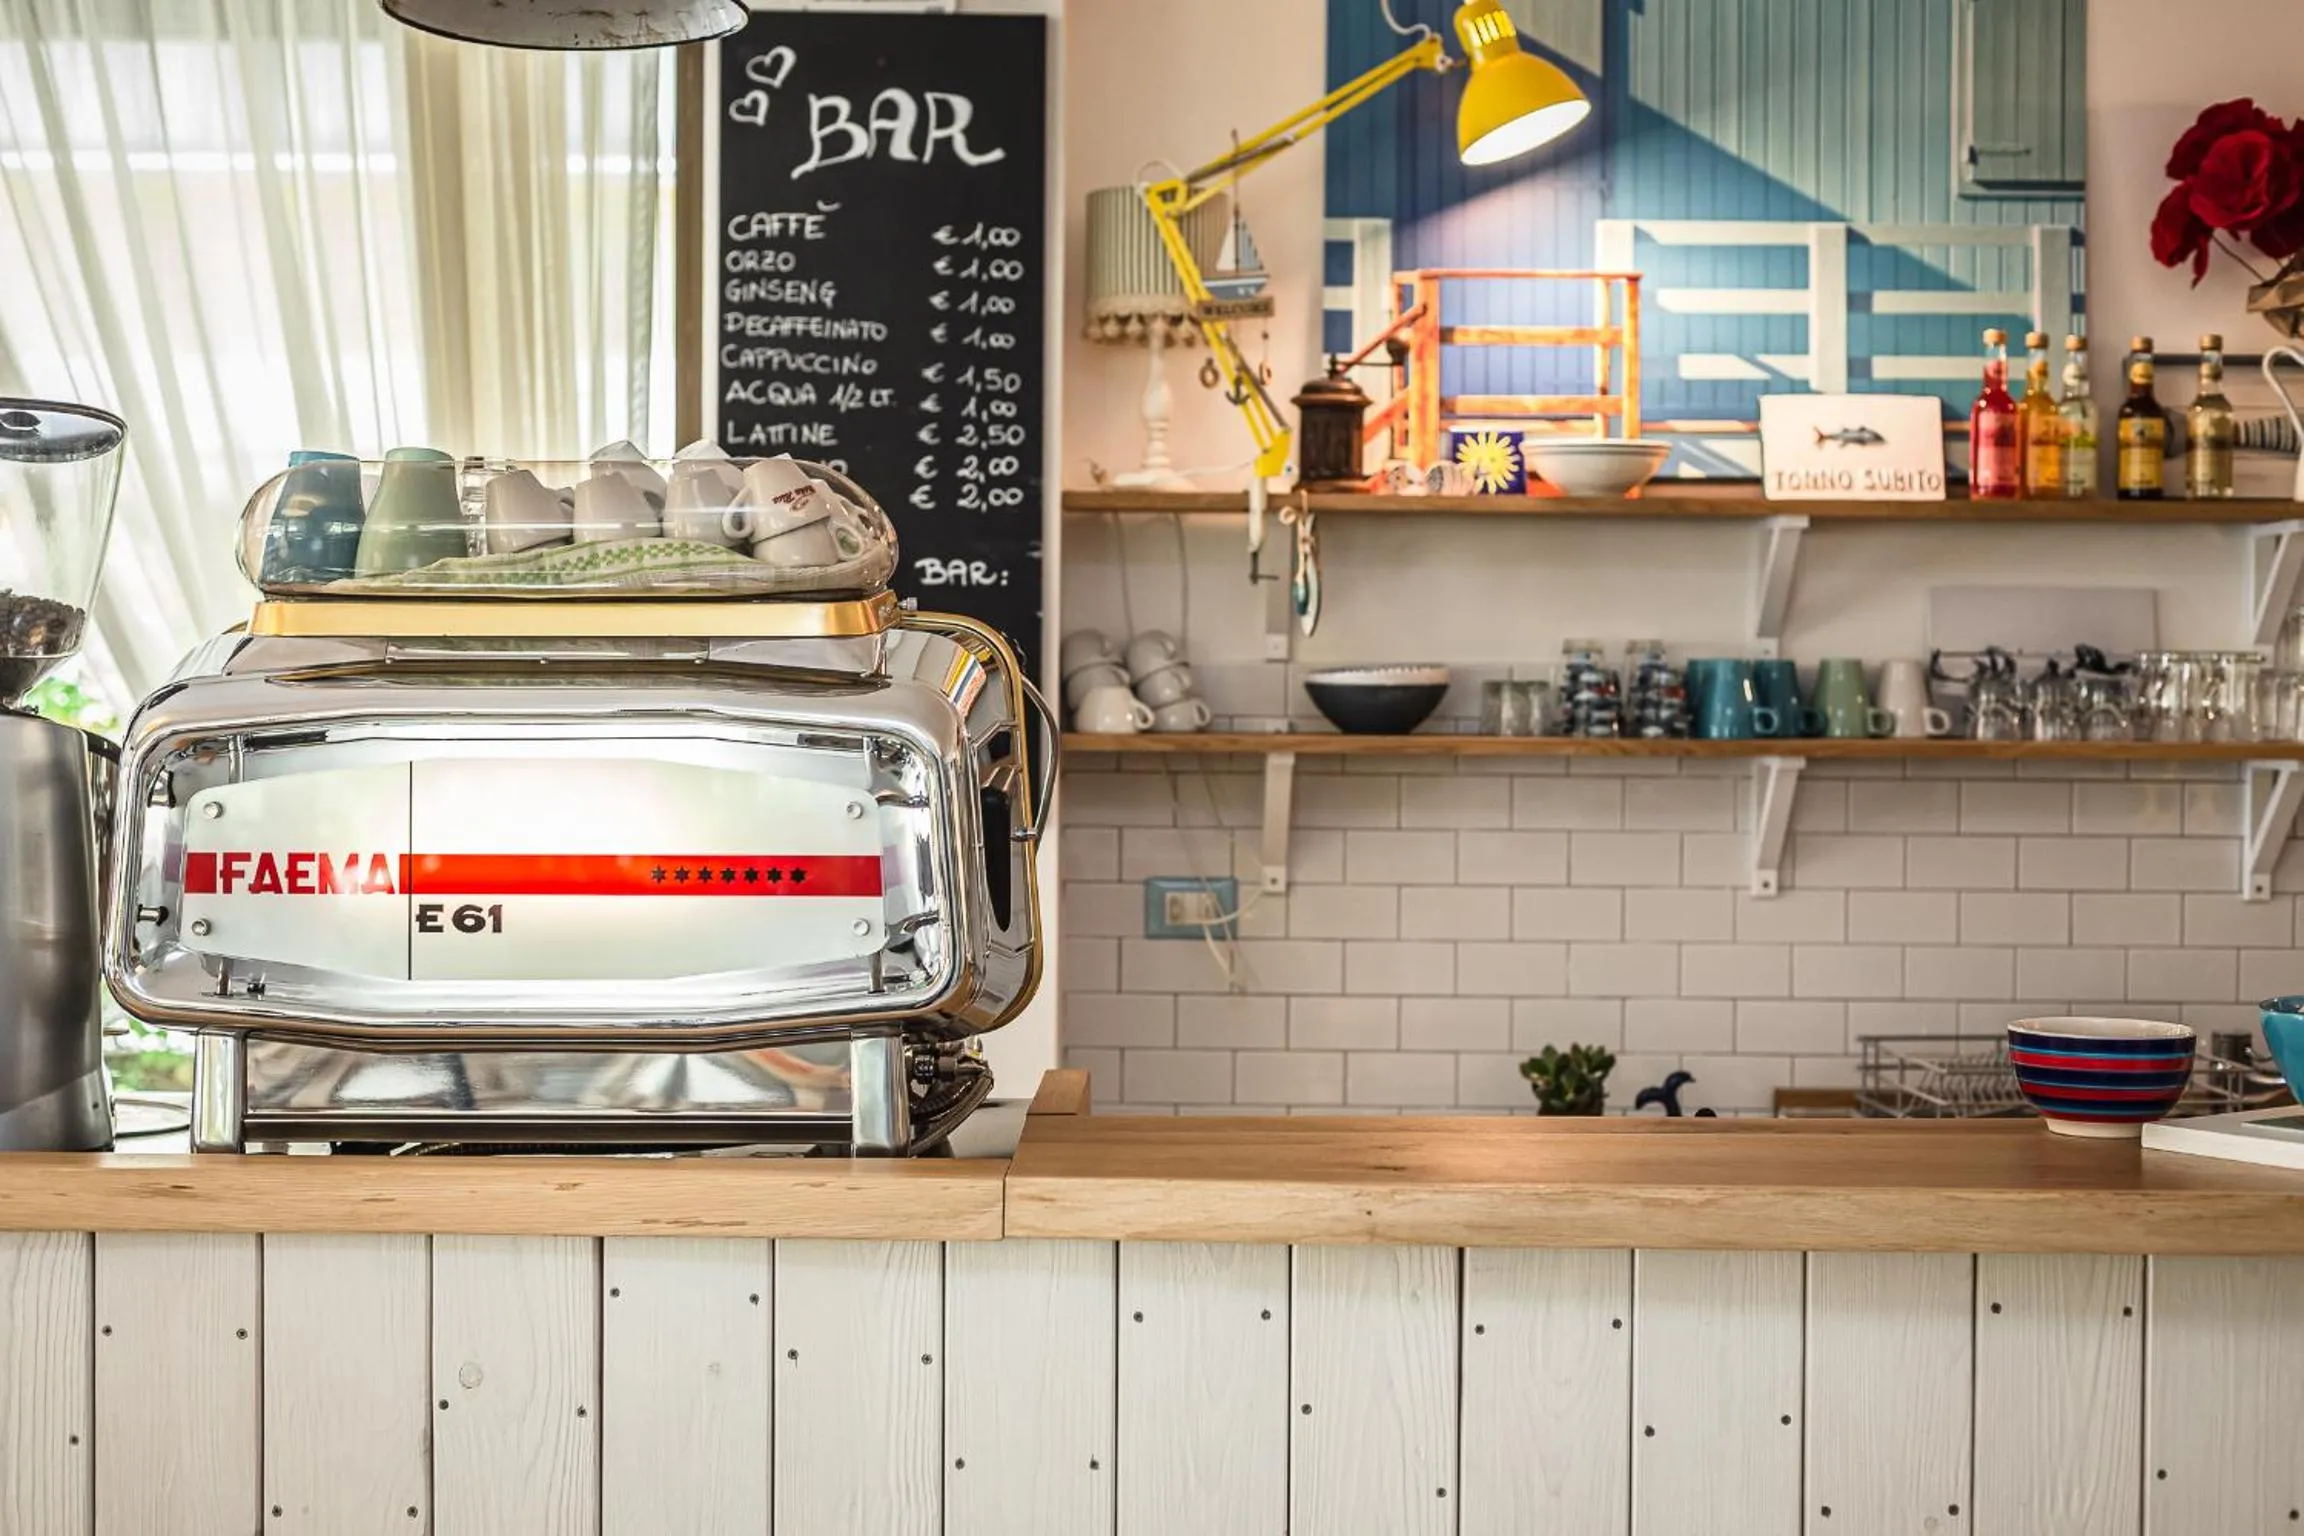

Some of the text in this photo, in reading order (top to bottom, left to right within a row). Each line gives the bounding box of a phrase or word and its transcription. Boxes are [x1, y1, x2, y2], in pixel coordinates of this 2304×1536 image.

[790, 88, 1006, 180] BAR
[932, 225, 957, 245] €
[962, 222, 1021, 250] 1,00
[725, 250, 1024, 281] ORZO € 1,00
[725, 278, 1015, 315] GINSENG € 1,00
[723, 312, 1015, 349] DECAFFEINATO € 1,00
[720, 343, 1021, 393] CAPPUCCINO € 1,50
[725, 380, 817, 406] ACQUA
[829, 382, 864, 413] 1/2
[919, 393, 942, 412] €
[961, 396, 1017, 423] 1,00
[727, 420, 1026, 450] LATTINE € 2,50
[914, 455, 1019, 484] € 2,00
[1776, 469, 1942, 492] TONNO SUBITO
[909, 484, 1024, 513] € 2,00
[914, 557, 1008, 586] BAR:
[220, 852, 395, 894] FAEMA
